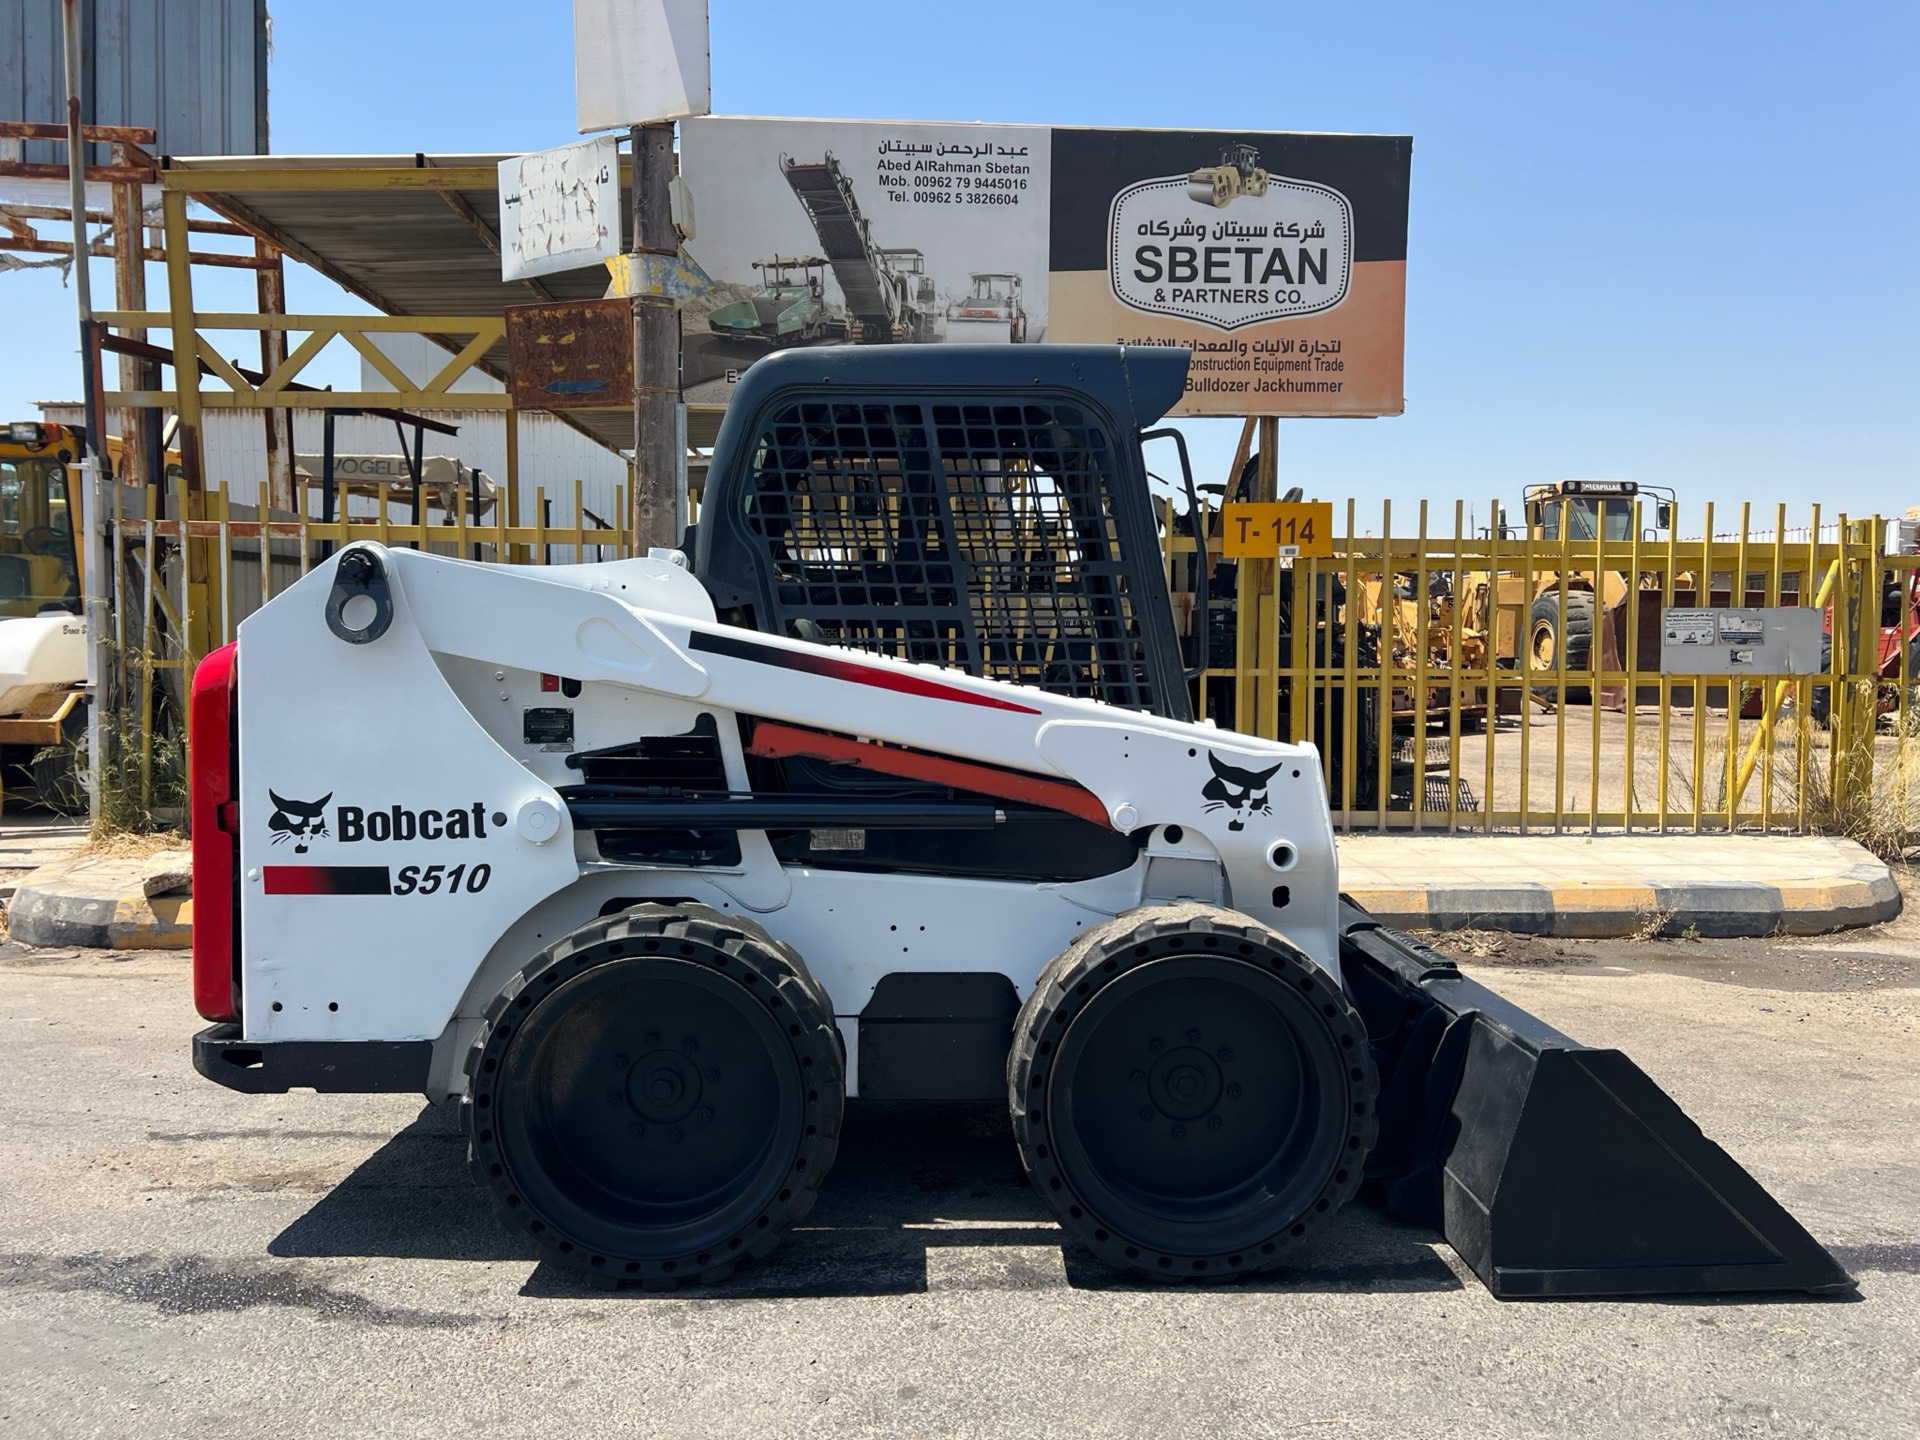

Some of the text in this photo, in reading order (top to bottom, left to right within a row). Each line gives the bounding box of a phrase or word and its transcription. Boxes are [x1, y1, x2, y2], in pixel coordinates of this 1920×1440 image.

[878, 140, 1028, 158] عبد الرحمن سبيتان
[877, 159, 911, 171] Abed
[985, 162, 1030, 174] Sbetan
[879, 175, 1027, 190] Mob. 00962 79 9445016
[887, 190, 1019, 205] Tel. 00962 5 3826604
[1138, 218, 1325, 243] شركة سبيتان وشركاه
[1134, 245, 1327, 285] SBETAN
[1154, 288, 1306, 304] & PARTNERS CO.
[1300, 340, 1341, 357] لتجارة
[1189, 357, 1344, 374] onstruction Equipment Trade
[1184, 378, 1343, 393] Bulldozer Jackhummer
[1235, 517, 1315, 544] T- 114
[338, 802, 487, 842] Bobcat
[393, 863, 491, 896] S510
